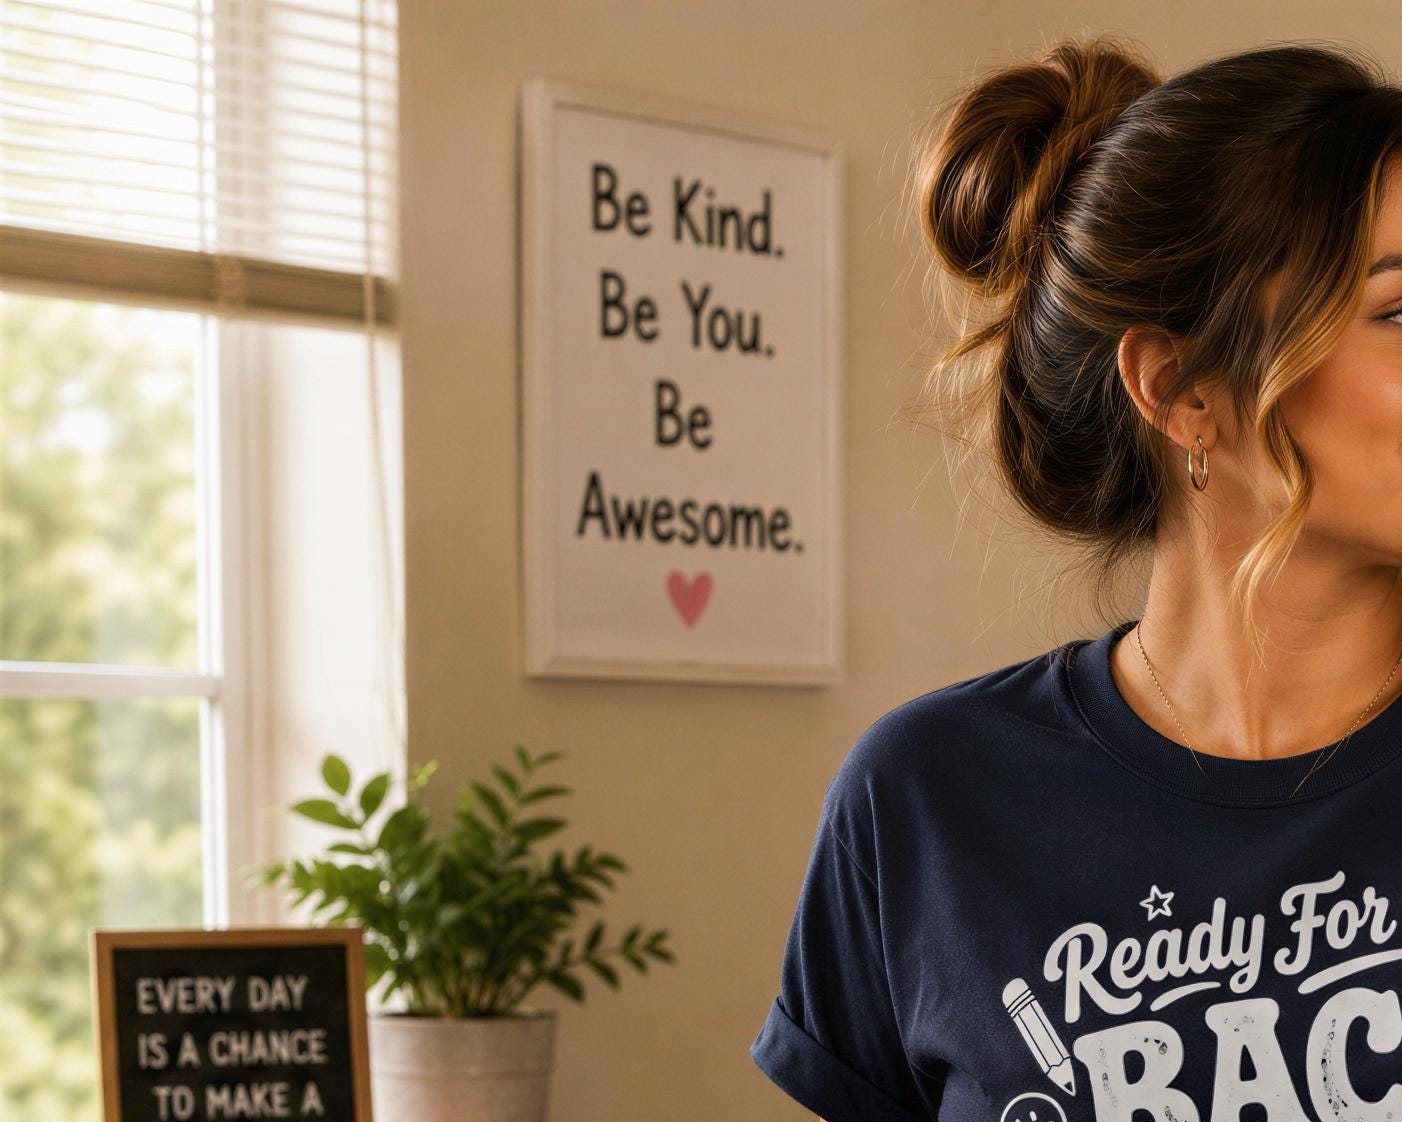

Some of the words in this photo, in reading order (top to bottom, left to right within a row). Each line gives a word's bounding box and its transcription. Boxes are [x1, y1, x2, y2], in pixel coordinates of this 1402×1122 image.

[590, 162, 652, 239] Be
[672, 174, 786, 258] Kind.
[600, 271, 660, 343] Be
[680, 279, 776, 356] You.
[655, 379, 713, 450] Be
[575, 471, 804, 553] Awesome.
[1043, 897, 1266, 1023] Ready
[1273, 869, 1397, 977] For
[136, 974, 236, 1015] EVERY
[247, 973, 308, 1013] DAY
[138, 1032, 170, 1070] IS
[176, 1030, 201, 1069] A
[208, 1028, 329, 1068] CHANCE
[153, 1084, 195, 1122] TO
[205, 1080, 291, 1121] MAKE
[301, 1080, 326, 1117] A
